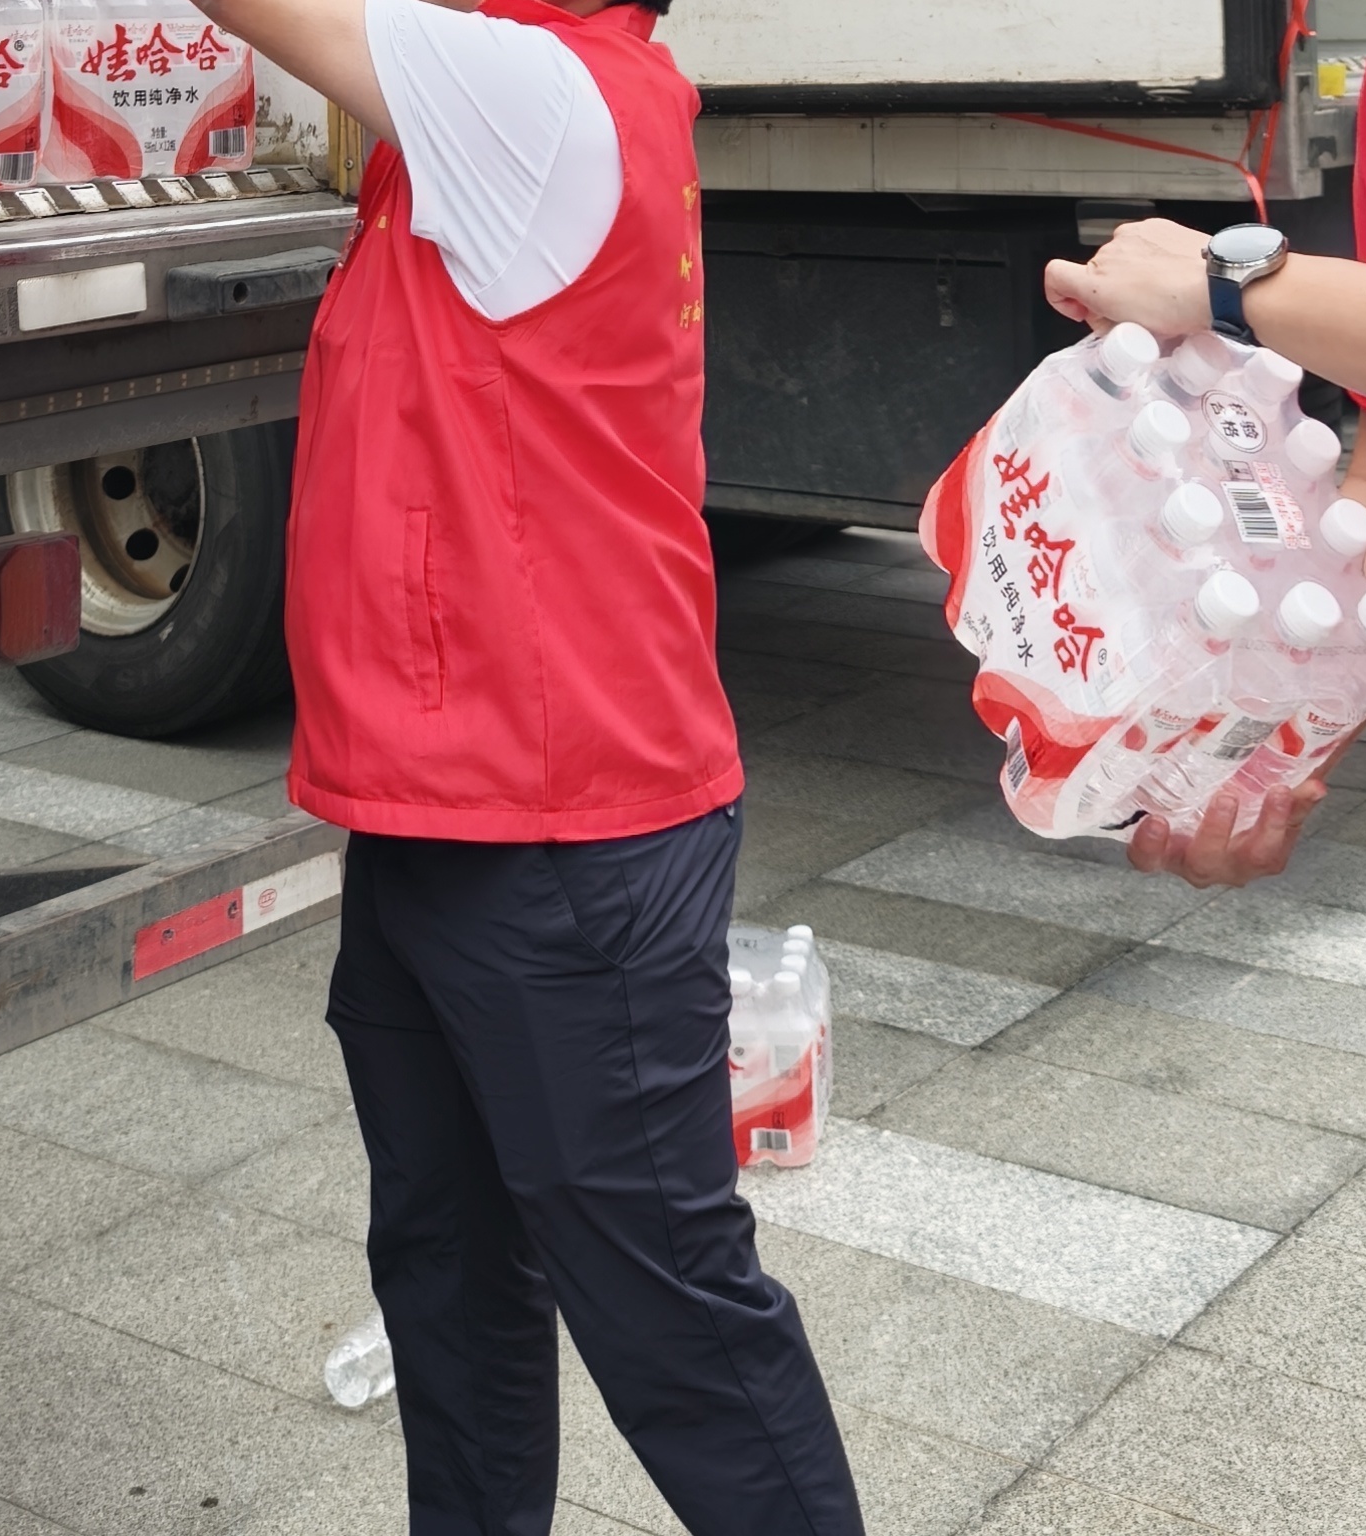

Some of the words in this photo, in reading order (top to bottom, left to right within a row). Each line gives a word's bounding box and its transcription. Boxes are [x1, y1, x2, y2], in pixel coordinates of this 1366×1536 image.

[81, 23, 229, 81] 娃哈哈
[112, 85, 200, 108] 饮用纯净水
[982, 525, 1035, 668] 饮用纯净水
[992, 448, 1105, 683] 娃哈哈
